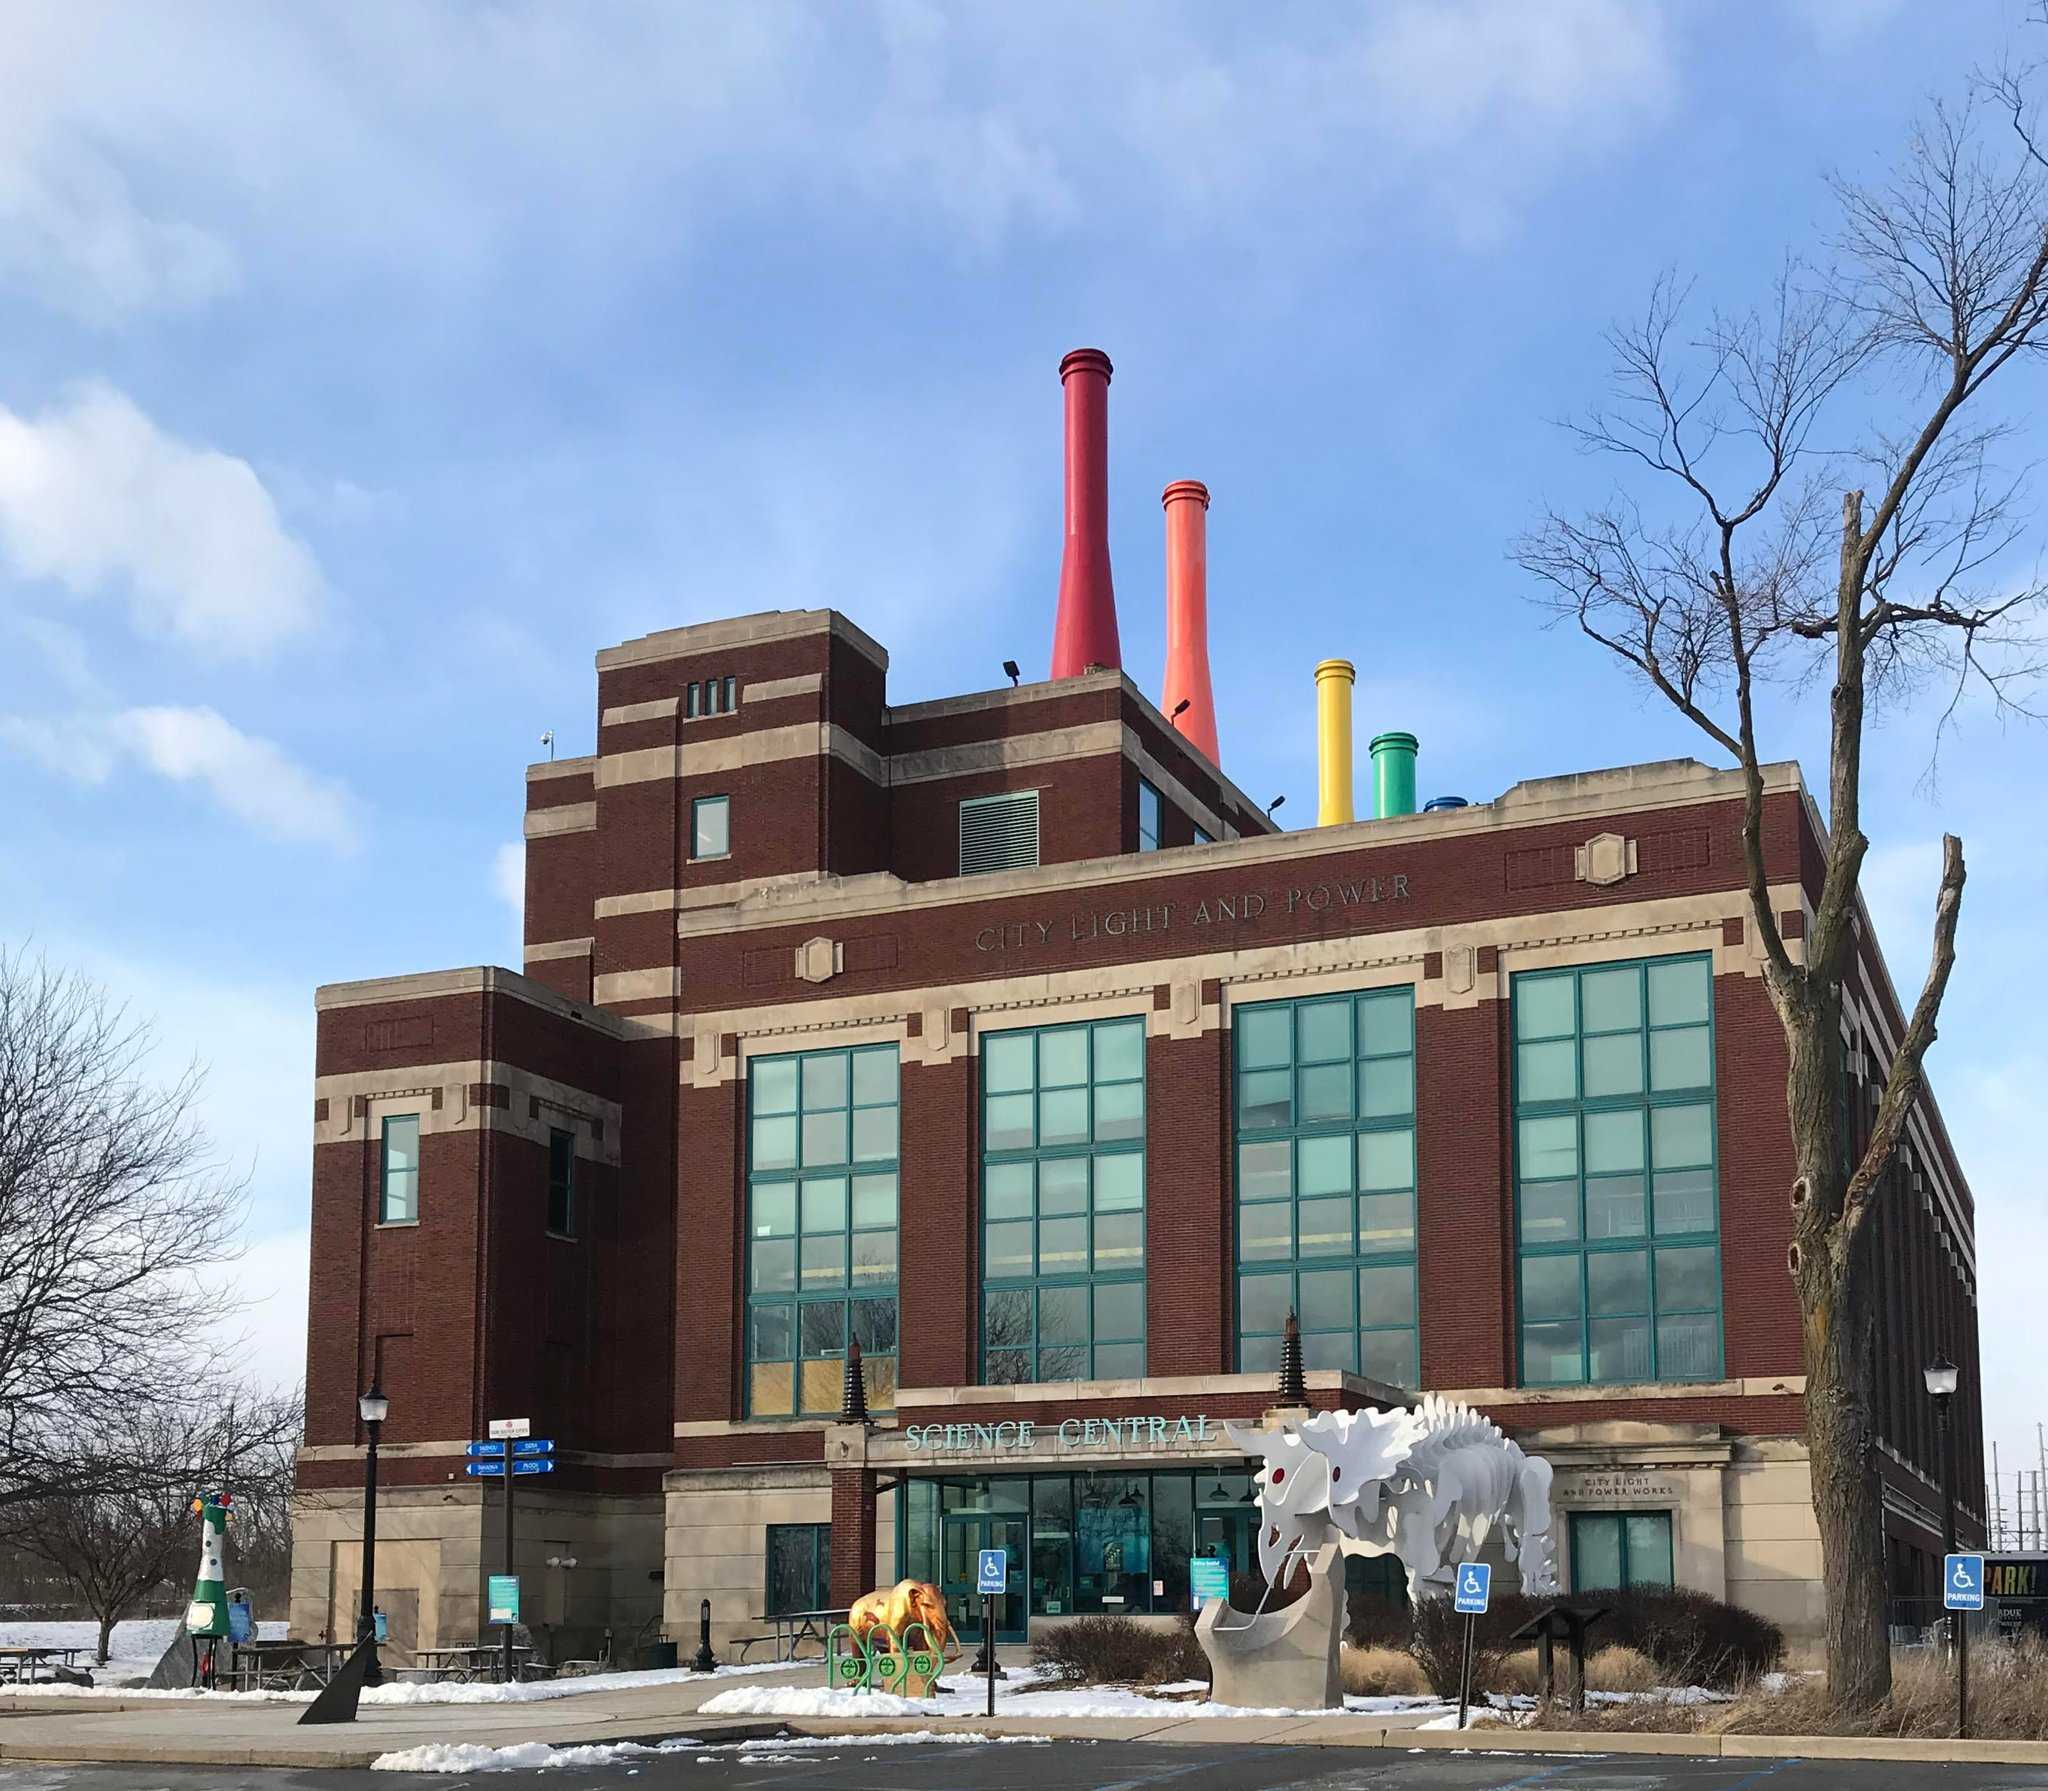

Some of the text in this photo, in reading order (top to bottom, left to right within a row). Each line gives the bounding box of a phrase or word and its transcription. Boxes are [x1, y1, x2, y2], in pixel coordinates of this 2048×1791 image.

[975, 873, 1410, 952] CITY LIGHT AND POWER
[904, 1413, 1218, 1451] SCIENCE CENTRAL
[1584, 1477, 1650, 1487] CITY LIGHT
[1562, 1486, 1673, 1498] AND POWER WORKS
[1457, 1596, 1486, 1607] PARKING
[1947, 1592, 1981, 1602] PARKING
